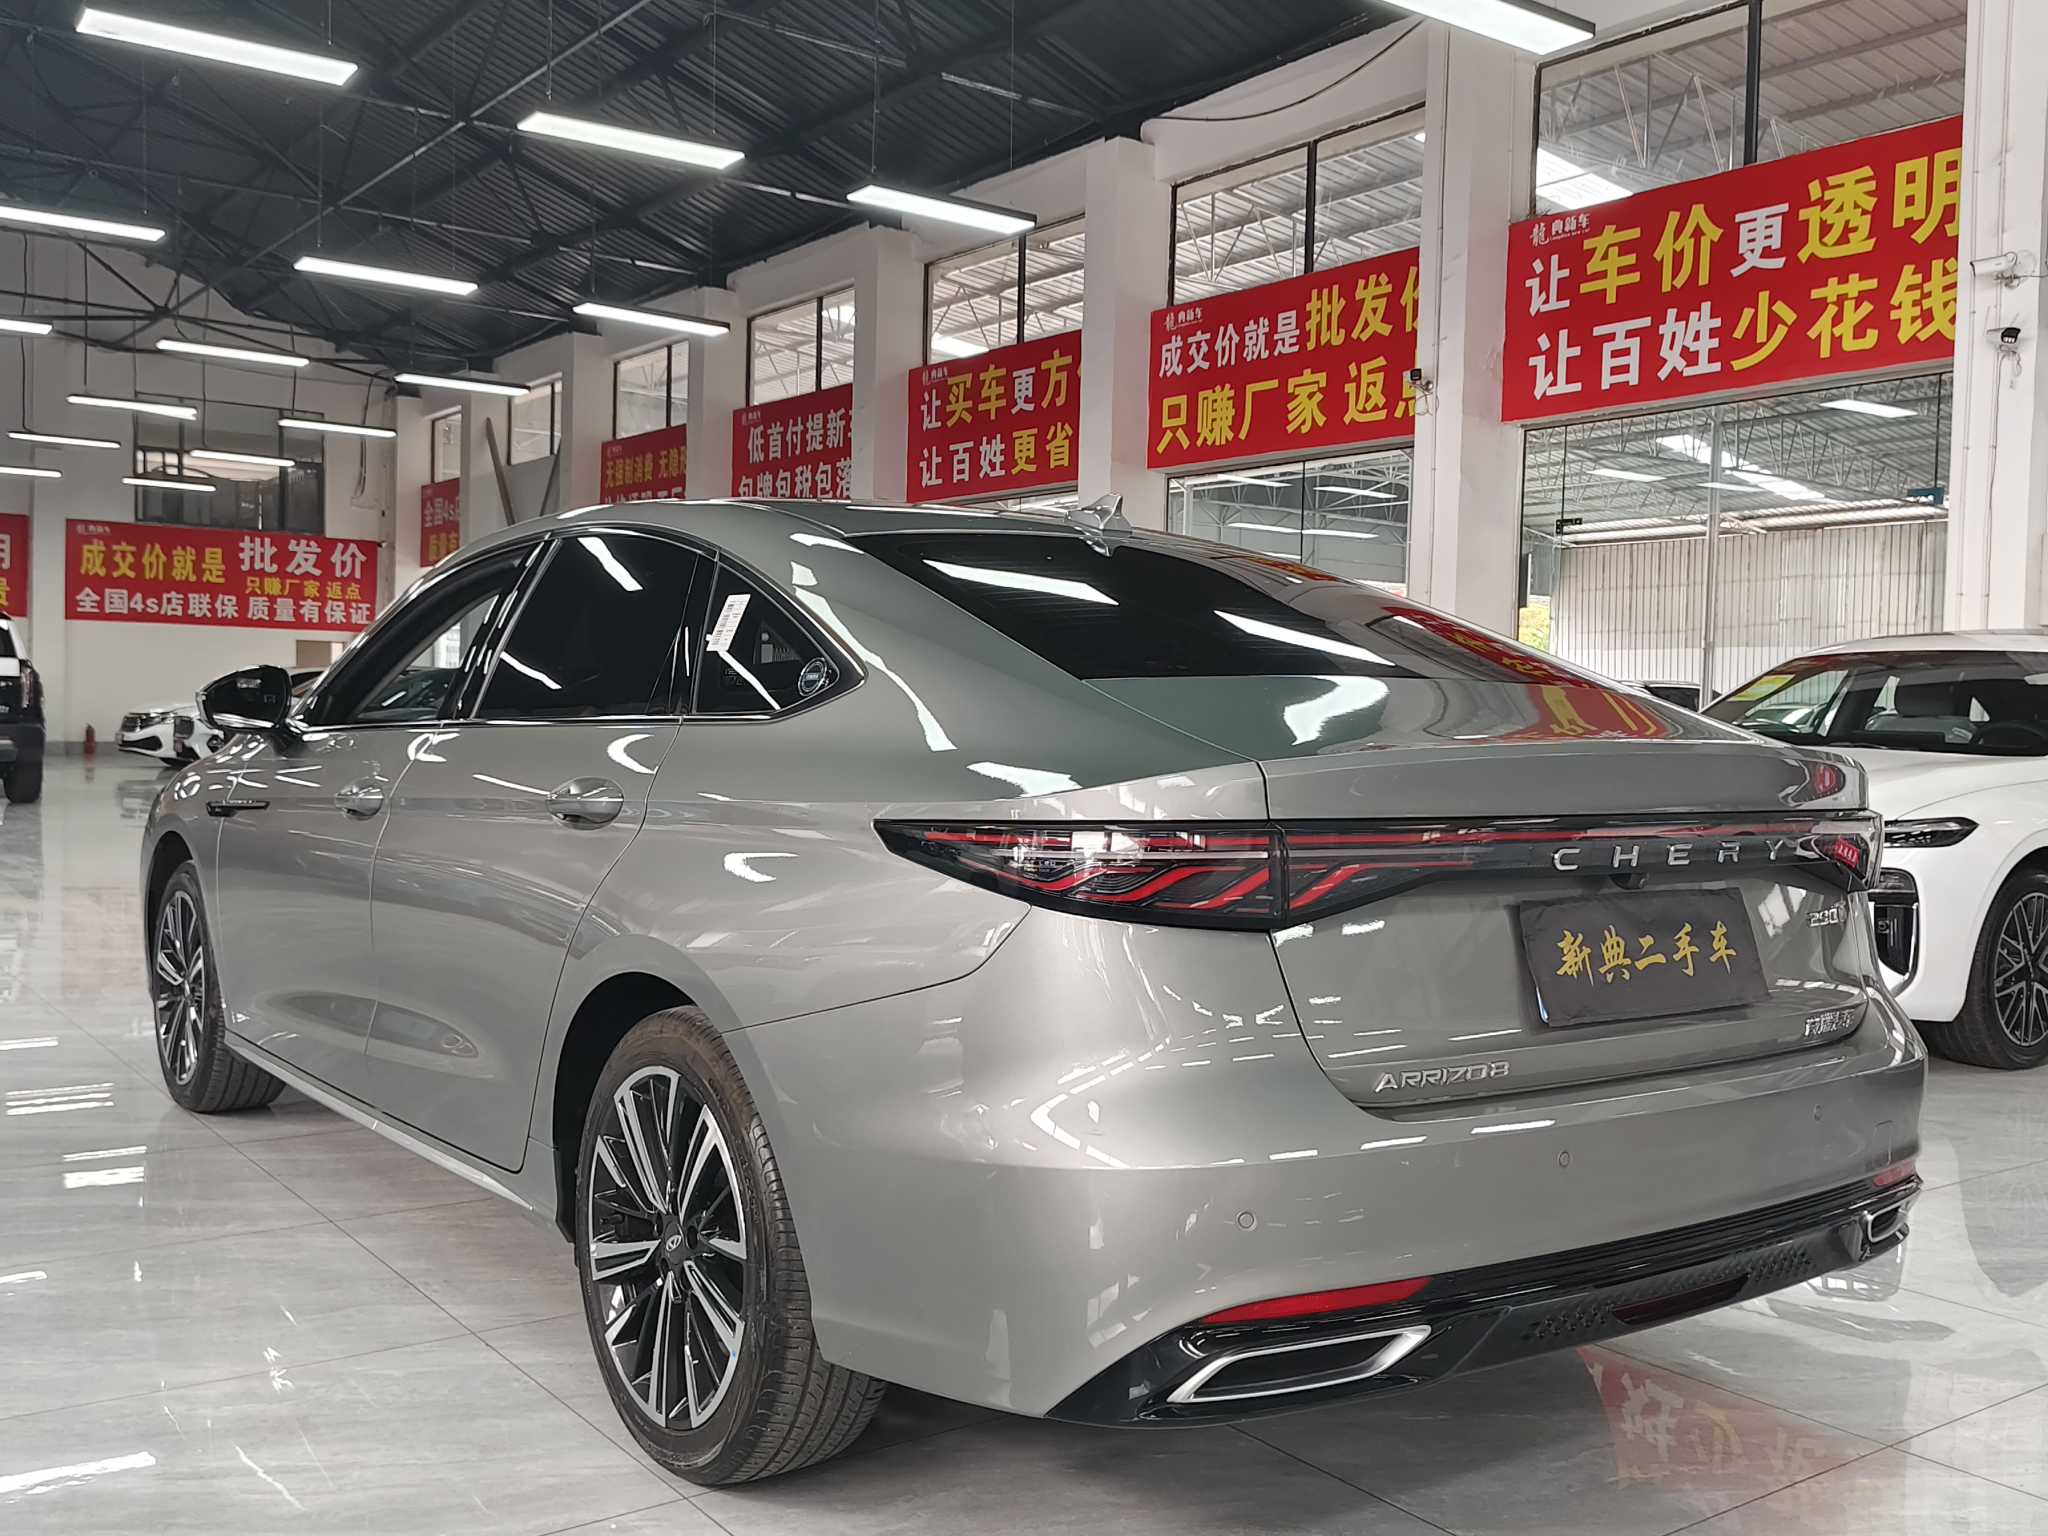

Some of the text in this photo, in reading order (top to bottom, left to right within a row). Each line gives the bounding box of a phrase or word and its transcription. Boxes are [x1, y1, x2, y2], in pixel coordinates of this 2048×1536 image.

[1525, 147, 1962, 317] 让车价更透明
[1528, 257, 1957, 400] 让百姓少花钱
[921, 349, 1081, 432] 让买车更方
[747, 408, 852, 464] 低首付提新
[919, 422, 1073, 488] 让百姓更省
[80, 536, 367, 584] 成交价就是 批发价
[76, 586, 372, 625] 全国4s店联保 质量有保证
[1553, 839, 1784, 871] CHERY
[1556, 920, 1737, 987] 新典二手车
